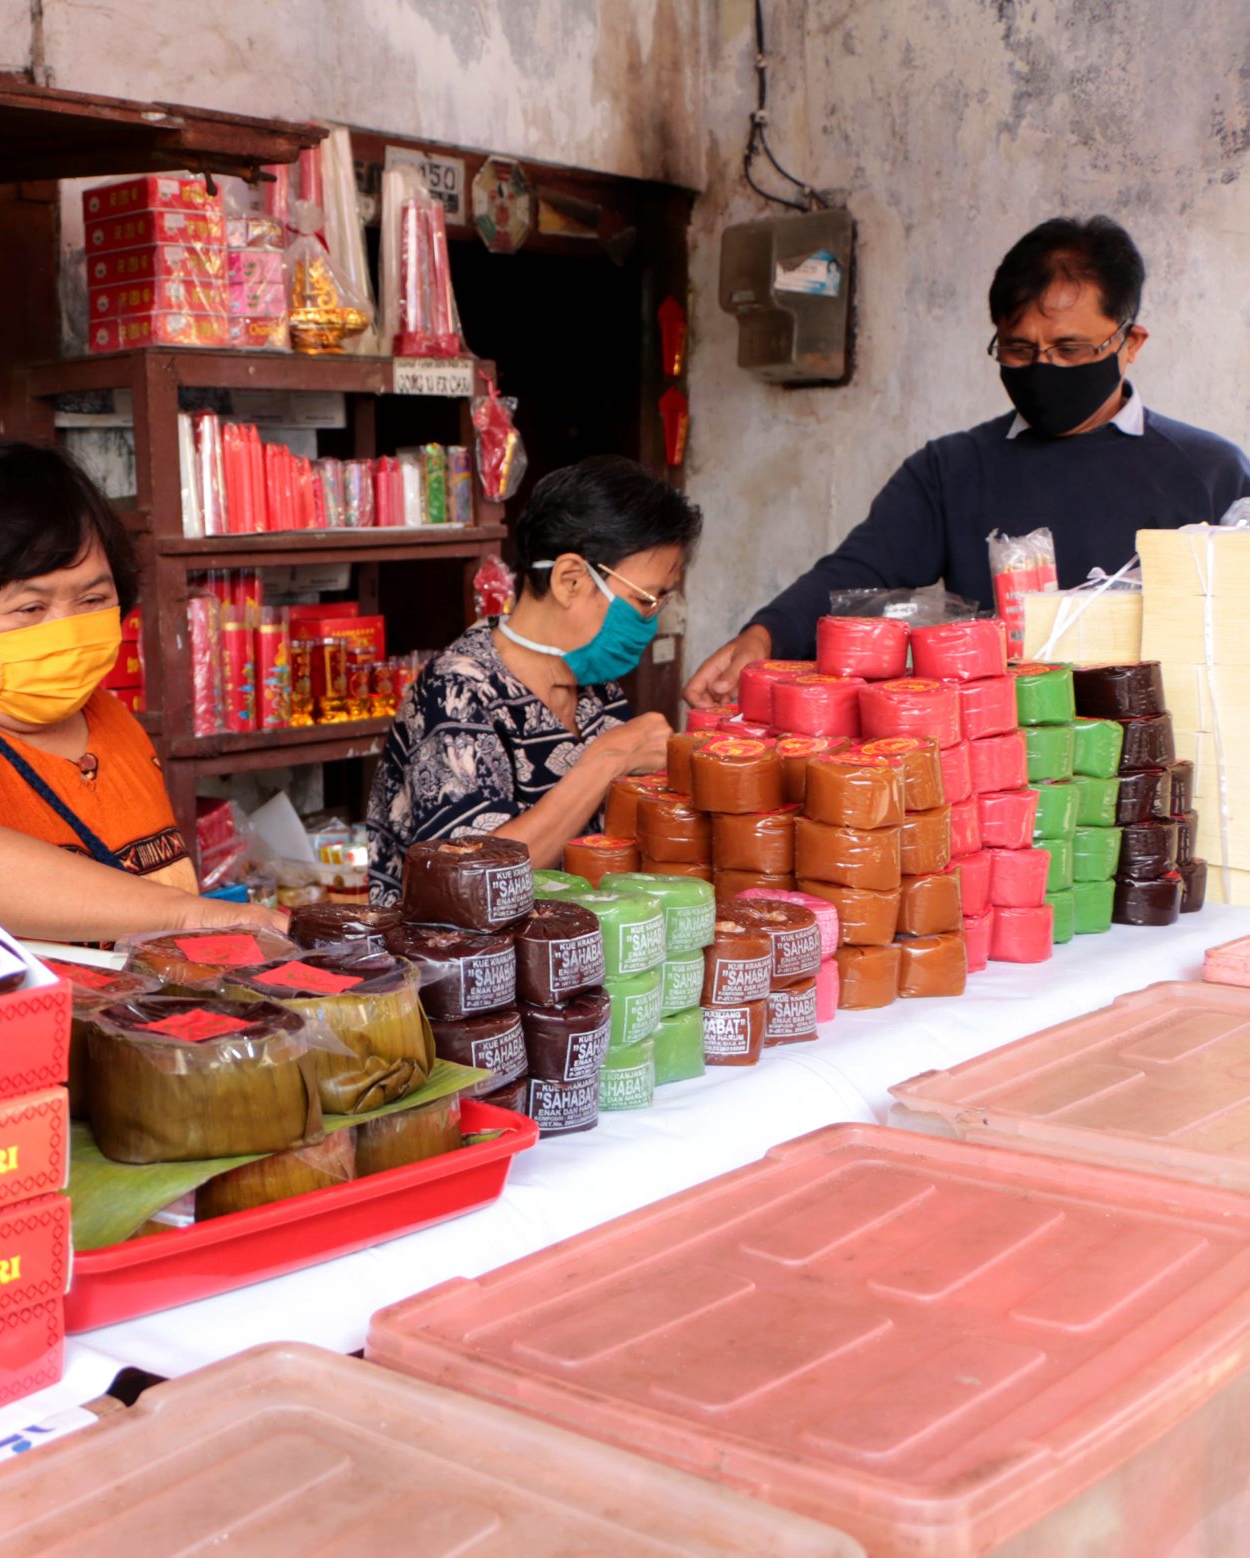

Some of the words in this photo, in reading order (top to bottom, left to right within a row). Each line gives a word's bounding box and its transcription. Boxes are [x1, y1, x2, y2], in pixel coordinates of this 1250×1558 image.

[560, 942, 577, 951] KUE
[473, 960, 489, 968] KUE
[470, 986, 491, 995] ENAK
[483, 1041, 498, 1050] KUE
[538, 1108, 561, 1117] ENAK
